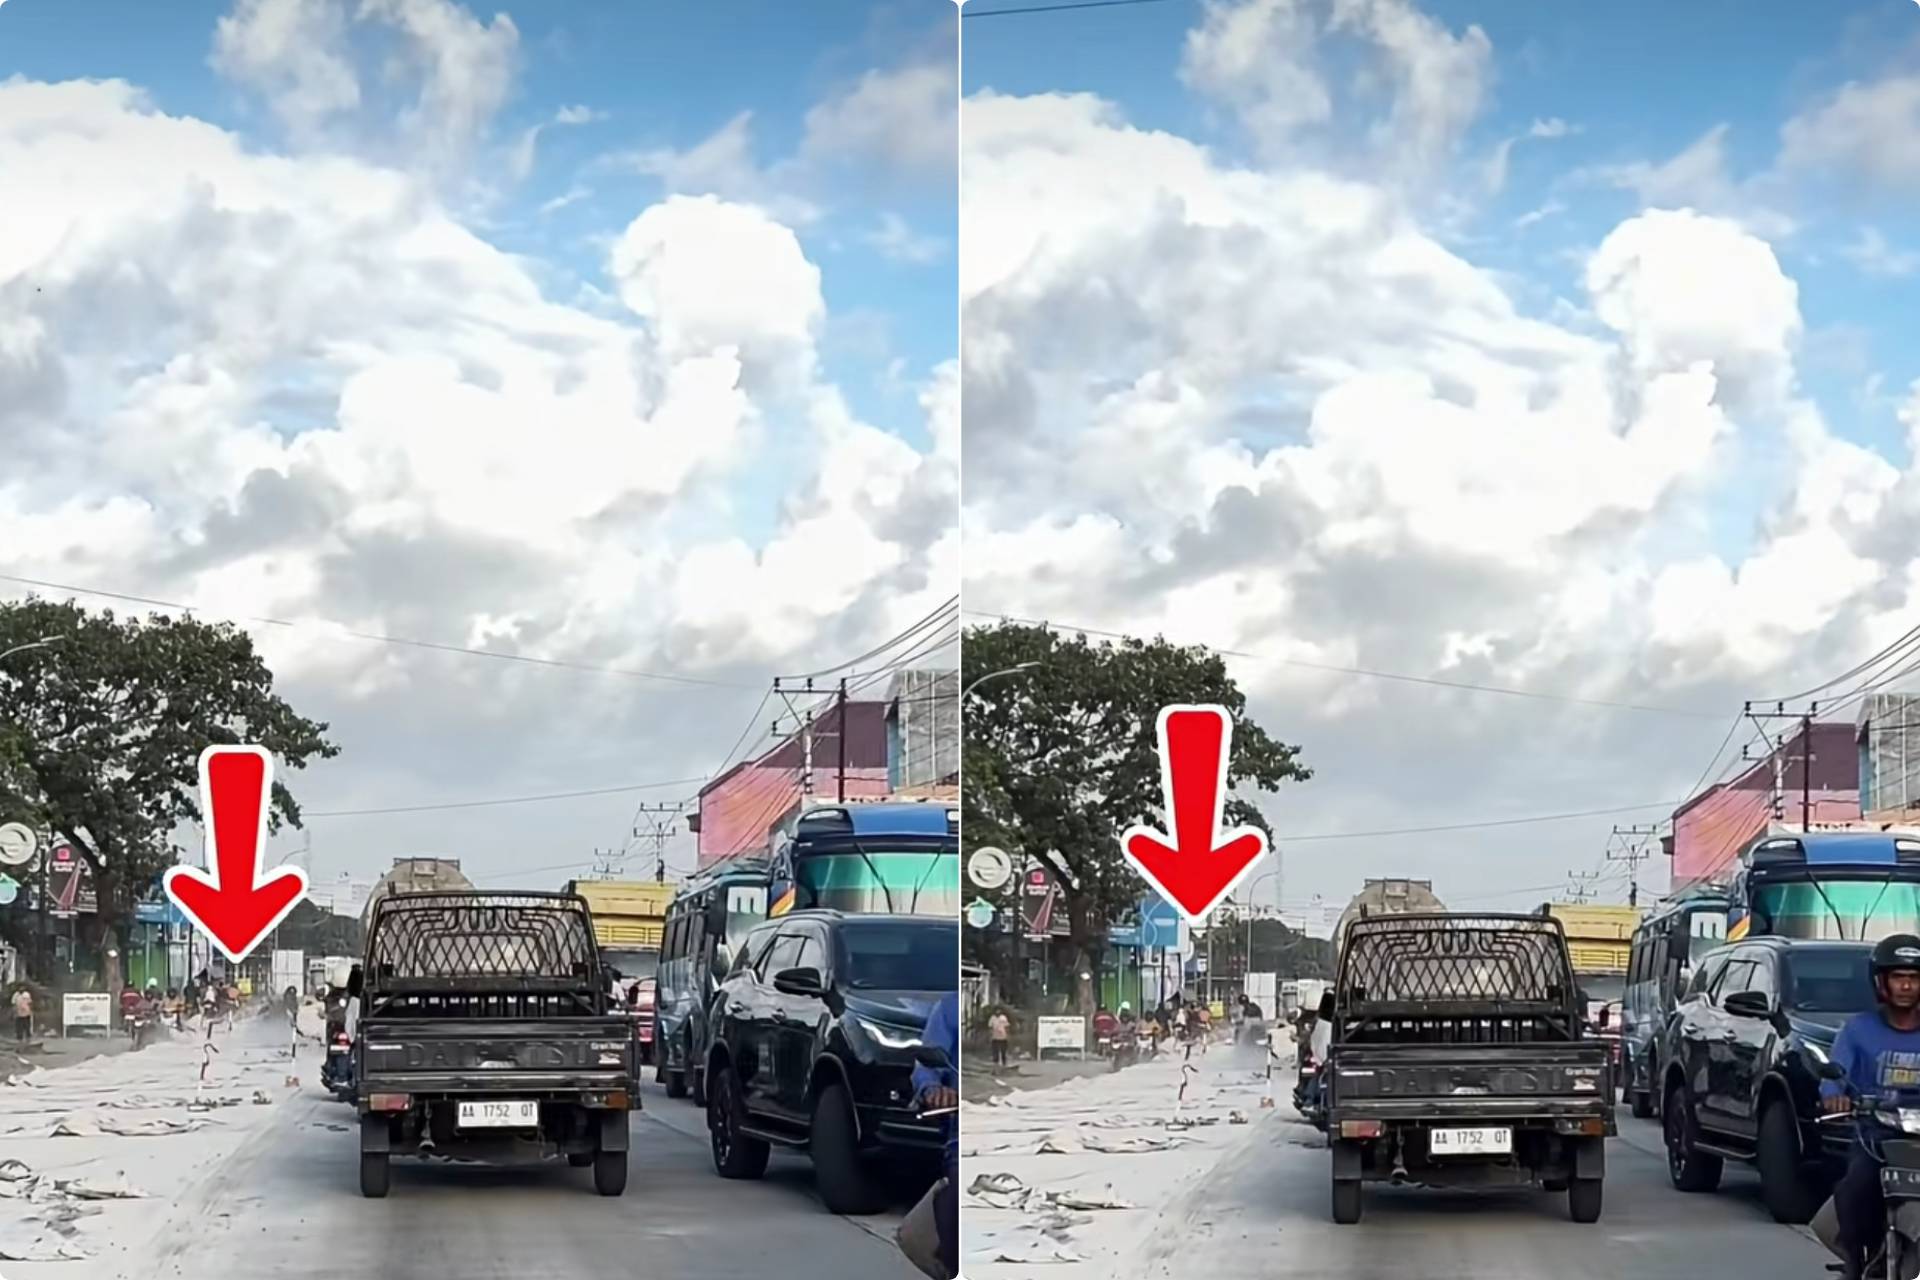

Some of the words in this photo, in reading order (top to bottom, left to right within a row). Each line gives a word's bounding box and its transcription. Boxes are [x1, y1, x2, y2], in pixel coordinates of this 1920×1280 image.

[462, 1105, 474, 1117] AA
[484, 1104, 510, 1117] 1752
[1435, 1131, 1448, 1144] AA
[1457, 1130, 1483, 1144] 1752
